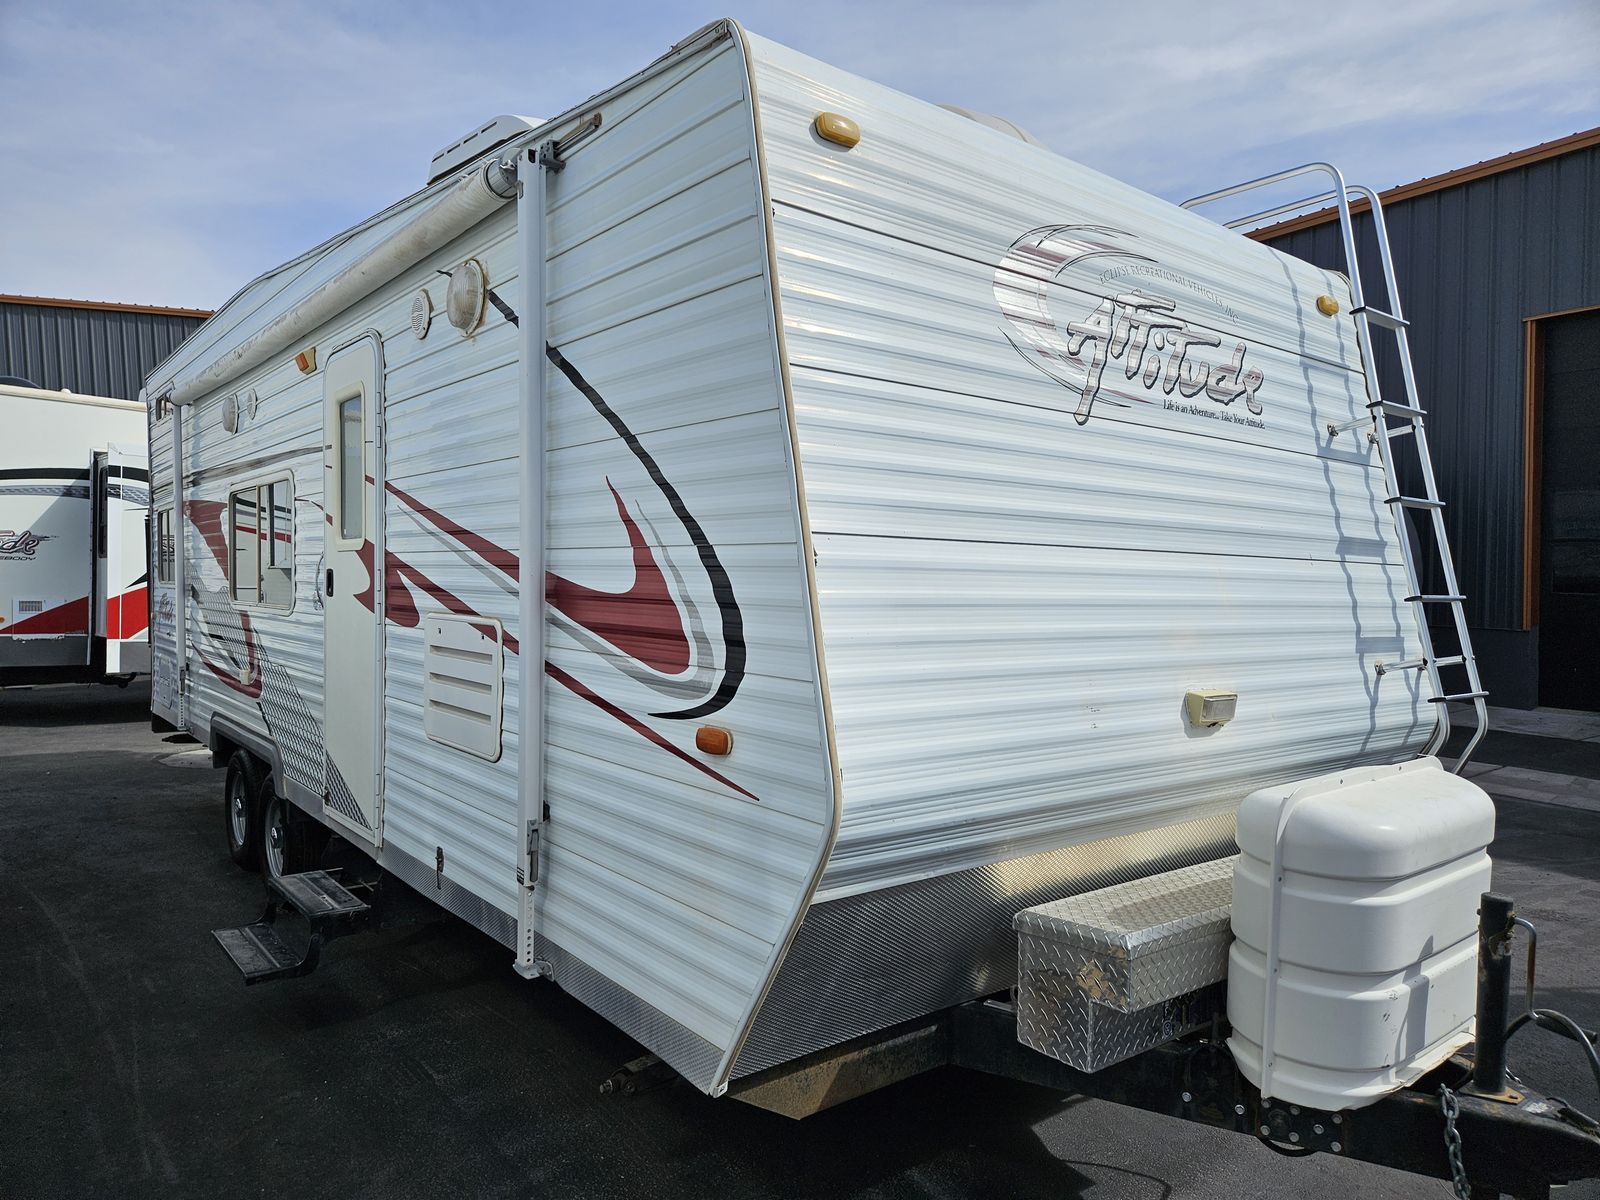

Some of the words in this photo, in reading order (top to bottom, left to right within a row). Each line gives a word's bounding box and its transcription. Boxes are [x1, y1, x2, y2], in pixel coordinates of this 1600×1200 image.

[1099, 265, 1130, 285] ECLIPSE
[1131, 265, 1187, 286] RECREATIONAL
[1163, 399, 1175, 411] Life
[1181, 405, 1188, 414] an
[1220, 411, 1233, 423] Take
[1233, 413, 1245, 425] Your
